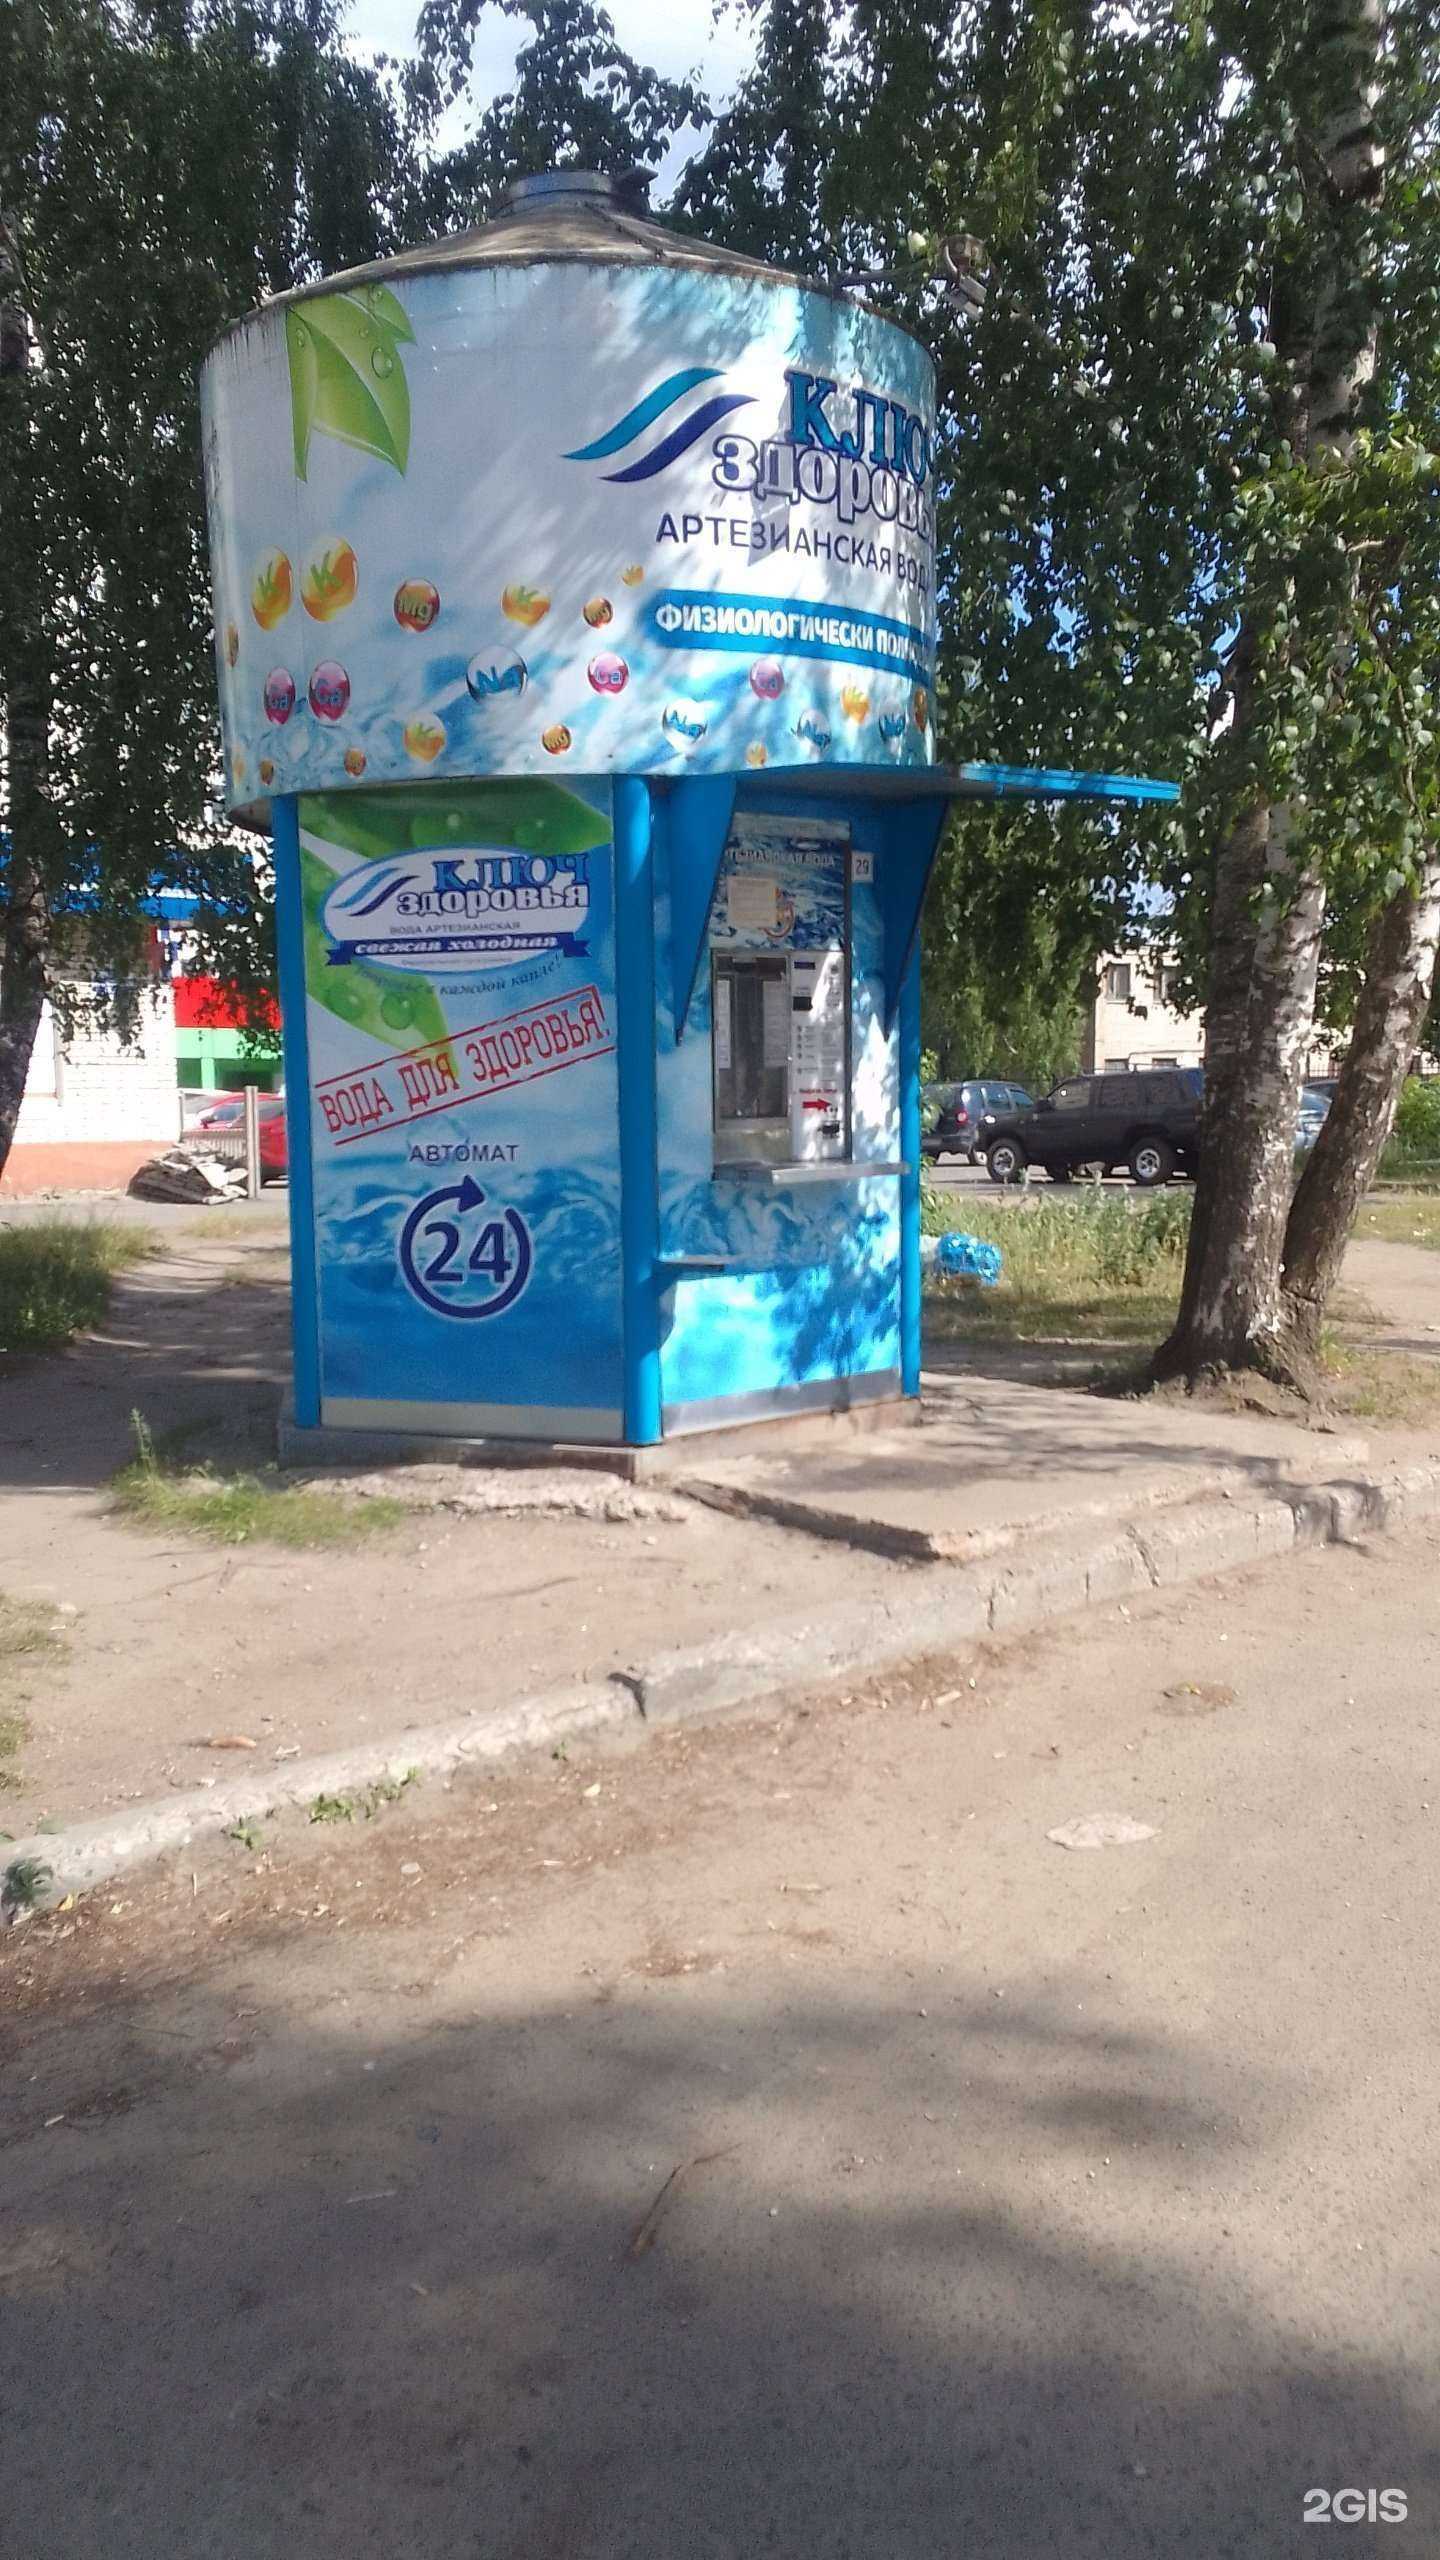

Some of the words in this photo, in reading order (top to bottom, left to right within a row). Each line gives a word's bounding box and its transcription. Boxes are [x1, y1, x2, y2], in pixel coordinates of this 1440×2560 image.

[656, 513, 891, 576] АРТЕЗИАНСКАЯ
[655, 603, 873, 653] ФИЗИОЛОГИЧЕСКИ
[431, 853, 588, 893] КЛЮЧ
[389, 925, 421, 935] ВОДА
[425, 921, 521, 933] АРТЕЗИАНСКАЯ
[318, 1077, 394, 1133] ВОДА
[397, 1053, 460, 1111] ДЛЯ
[465, 995, 610, 1083] ЗДОРОВЬЯ!
[409, 1144, 519, 1162] АВТОМАТ
[424, 1221, 513, 1283] 24
